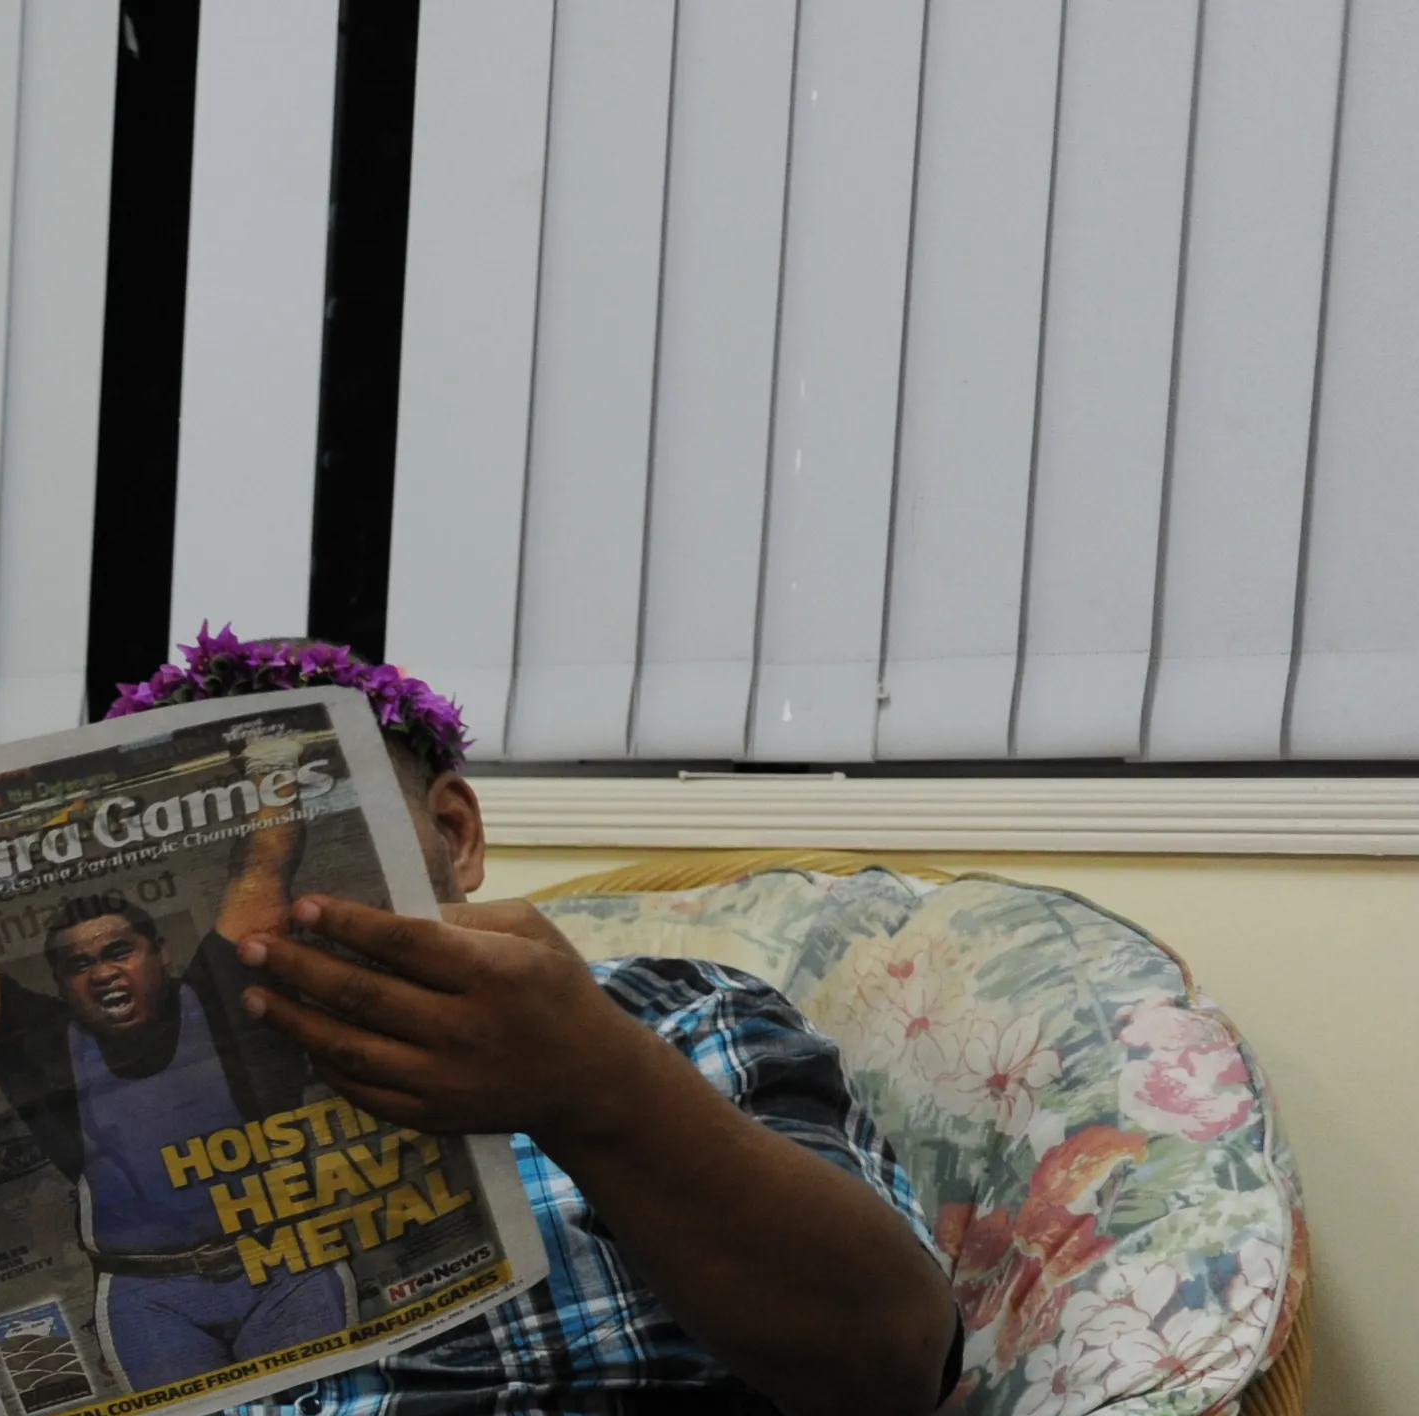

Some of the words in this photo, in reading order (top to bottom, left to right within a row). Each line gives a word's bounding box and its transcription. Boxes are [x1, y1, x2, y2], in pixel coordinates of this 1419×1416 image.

[74, 840, 180, 879] Paralympic
[181, 805, 330, 847] Championships
[92, 758, 336, 848] Games
[159, 1096, 379, 1189] HOISTI
[209, 1128, 442, 1235] HEAVY
[235, 1167, 473, 1287] METAL
[388, 1279, 418, 1302] NT
[106, 1375, 205, 1416] COVERAGE
[206, 1362, 259, 1389] FROM
[262, 1351, 300, 1371] THE
[301, 1336, 347, 1358] 2011
[348, 1303, 437, 1345] ARAFURA
[436, 1269, 500, 1309] GAMES
